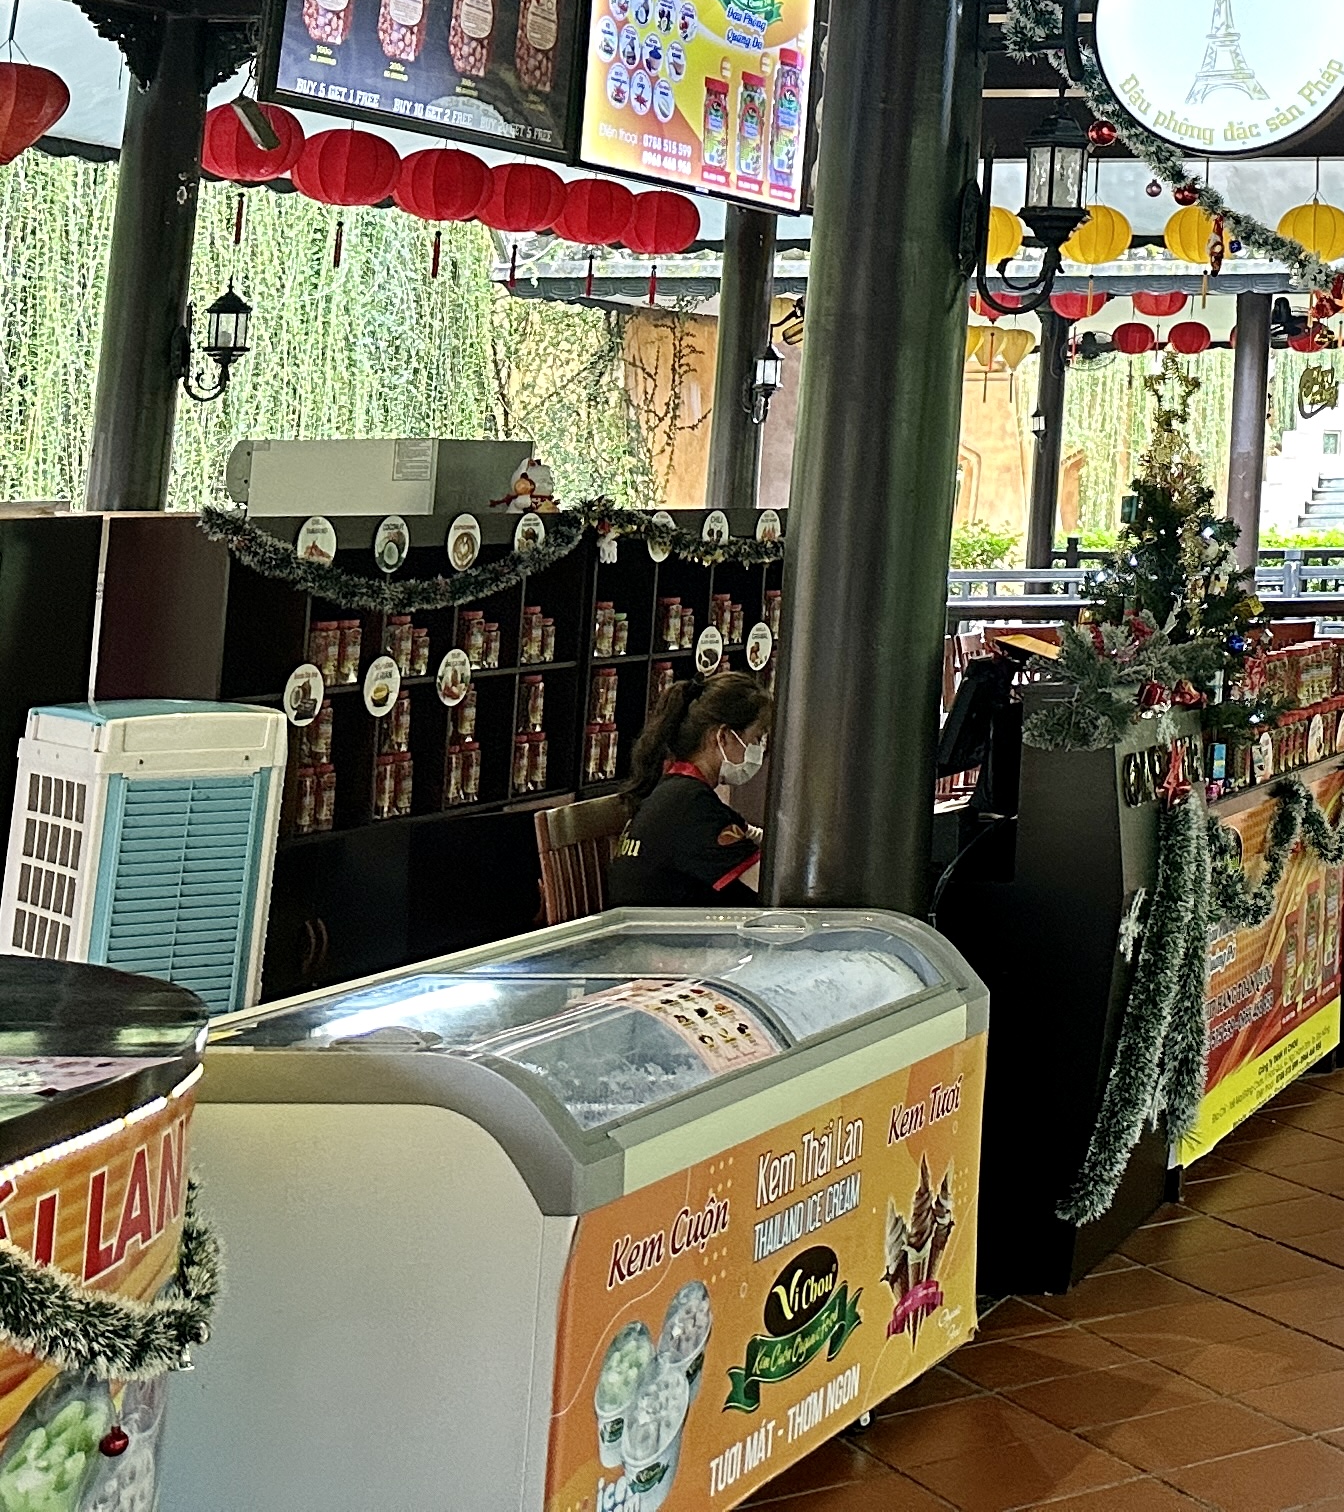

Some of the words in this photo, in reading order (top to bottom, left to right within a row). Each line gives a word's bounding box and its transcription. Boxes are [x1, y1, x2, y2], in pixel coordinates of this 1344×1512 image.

[295, 78, 317, 96] BUY
[318, 82, 326, 98] 5
[328, 85, 347, 103] GET
[349, 89, 355, 104] 1
[356, 90, 380, 108] FREE
[393, 97, 412, 115] BUY
[413, 102, 424, 118] 10
[425, 105, 442, 122] GET
[443, 109, 450, 122] 2
[451, 110, 473, 126] FREE
[1118, 73, 1150, 117] Đậu
[1153, 107, 1215, 146] phộng
[1223, 121, 1261, 146] đặc
[1265, 101, 1305, 134] sản
[533, 128, 552, 143] FREE
[662, 139, 677, 155] 515
[887, 1105, 925, 1146] Kem
[929, 1075, 963, 1126] Tươi
[755, 1152, 796, 1208] Kem
[836, 1117, 863, 1170] Lan
[82, 1115, 187, 1286] LAN
[754, 1202, 803, 1262] THAILAND
[804, 1193, 822, 1236] ICE
[823, 1172, 861, 1223] CREAM
[607, 1235, 664, 1291] Kem
[671, 1197, 730, 1261] Cuộn
[772, 1269, 803, 1320] Vi
[802, 1273, 833, 1309] Chou
[709, 1445, 742, 1497] TƯƠI
[743, 1418, 776, 1471] MÁT
[787, 1395, 823, 1451] THƠM
[824, 1363, 862, 1424] NGON
